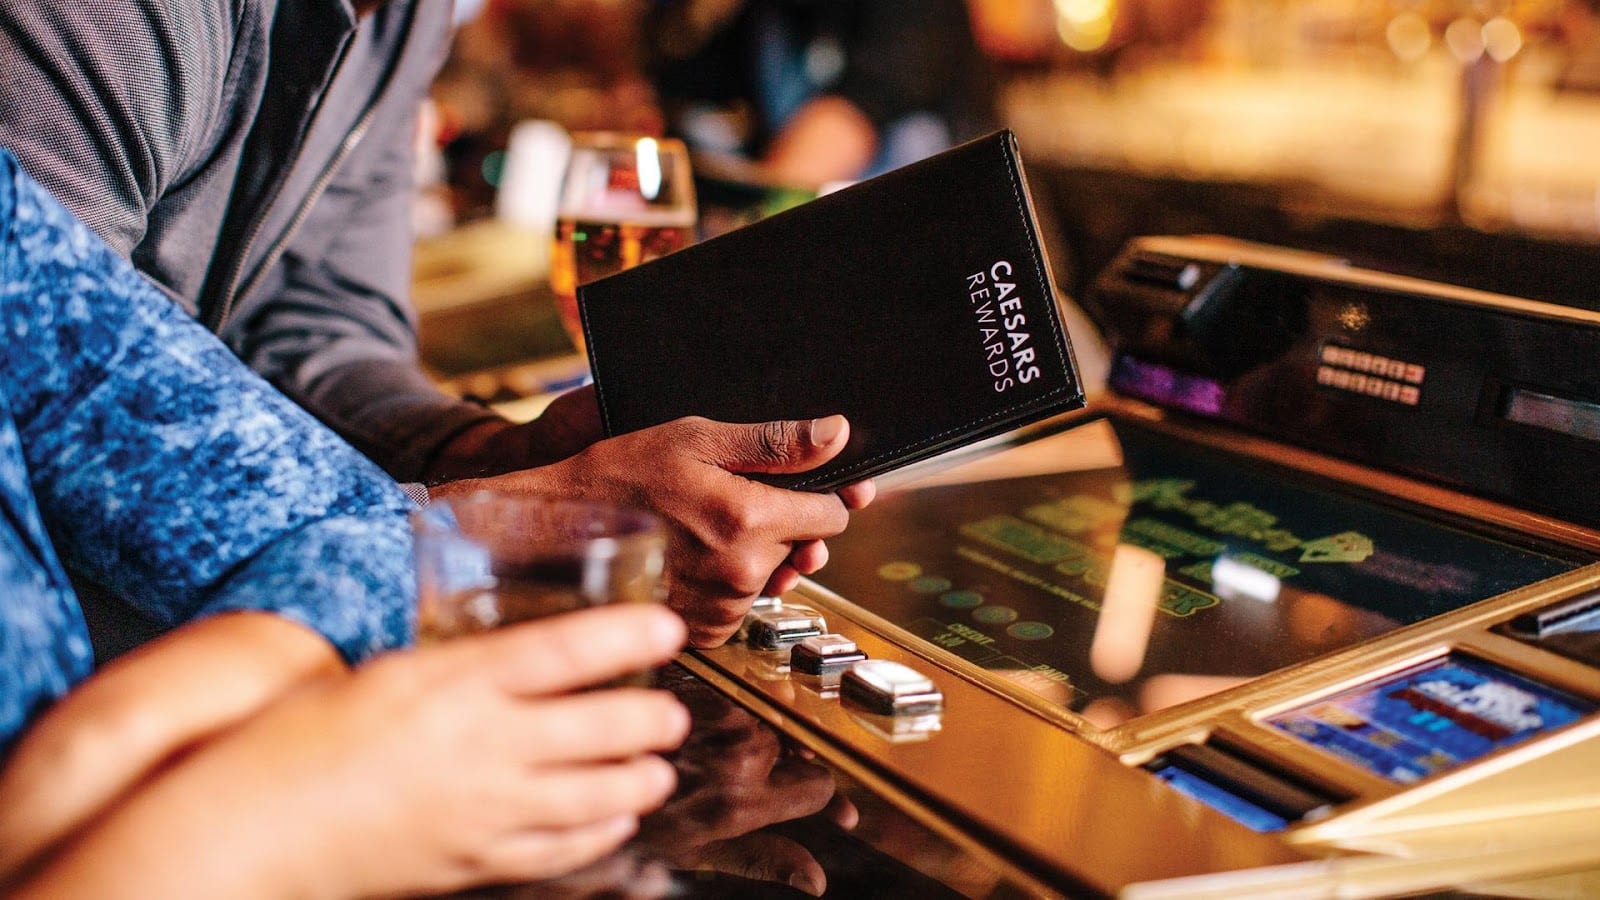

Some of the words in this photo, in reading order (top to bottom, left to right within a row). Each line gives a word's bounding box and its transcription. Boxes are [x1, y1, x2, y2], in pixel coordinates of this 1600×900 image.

[966, 271, 1014, 393] REWARDS
[990, 260, 1040, 384] CAESARS
[947, 623, 995, 645] CREDIT
[1031, 664, 1070, 682] PAID
